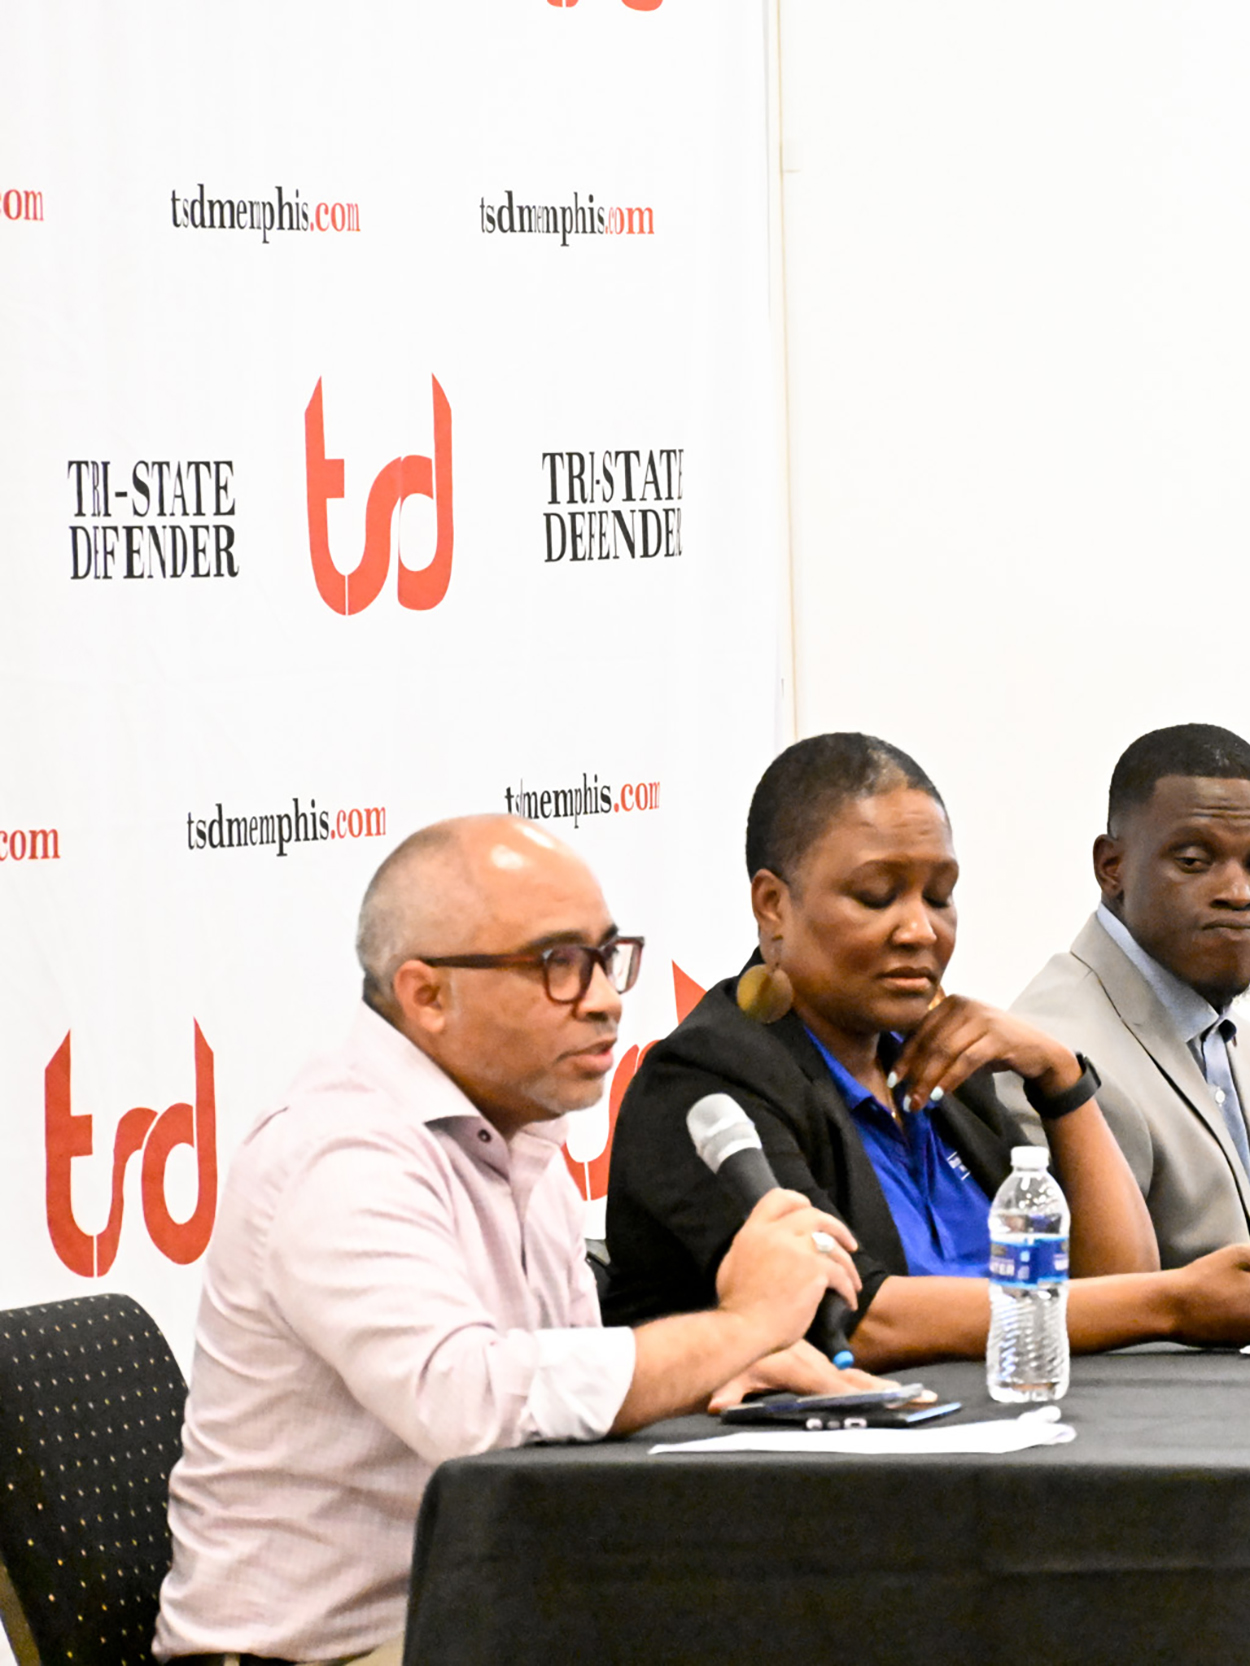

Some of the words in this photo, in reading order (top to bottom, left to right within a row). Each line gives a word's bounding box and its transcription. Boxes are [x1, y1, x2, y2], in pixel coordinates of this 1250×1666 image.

[0, 188, 44, 222] om
[171, 183, 361, 244] tsdmemphis.com
[479, 190, 655, 247] tsdmemphis.com
[67, 460, 236, 518] TRI-STATE
[68, 524, 240, 580] DEFENDER
[187, 798, 386, 857] tsdmemphis.com
